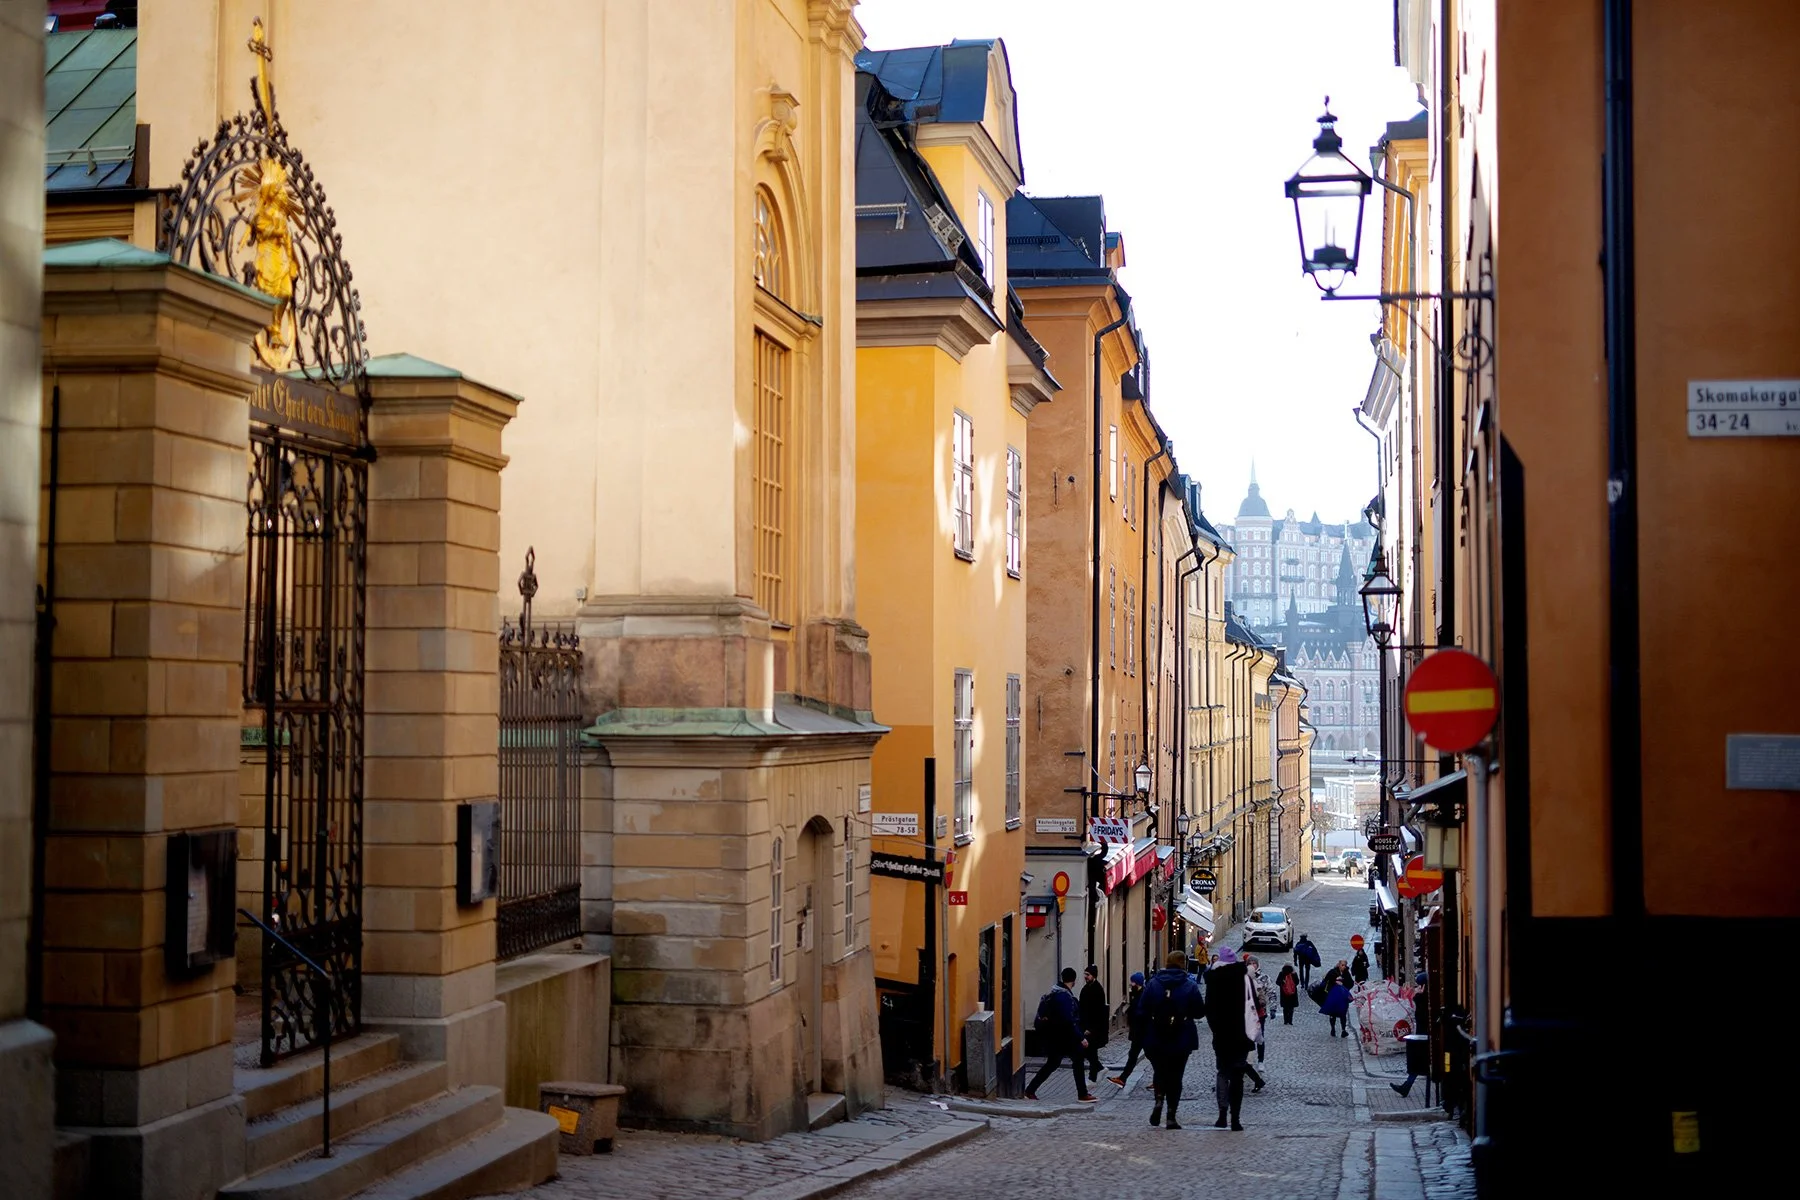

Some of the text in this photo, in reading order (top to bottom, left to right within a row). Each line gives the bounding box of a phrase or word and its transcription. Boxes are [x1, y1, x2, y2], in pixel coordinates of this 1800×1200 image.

[1696, 413, 1751, 431] 34-24
[881, 816, 916, 824] Prästgatan
[1098, 826, 1123, 836] FRIDAYS
